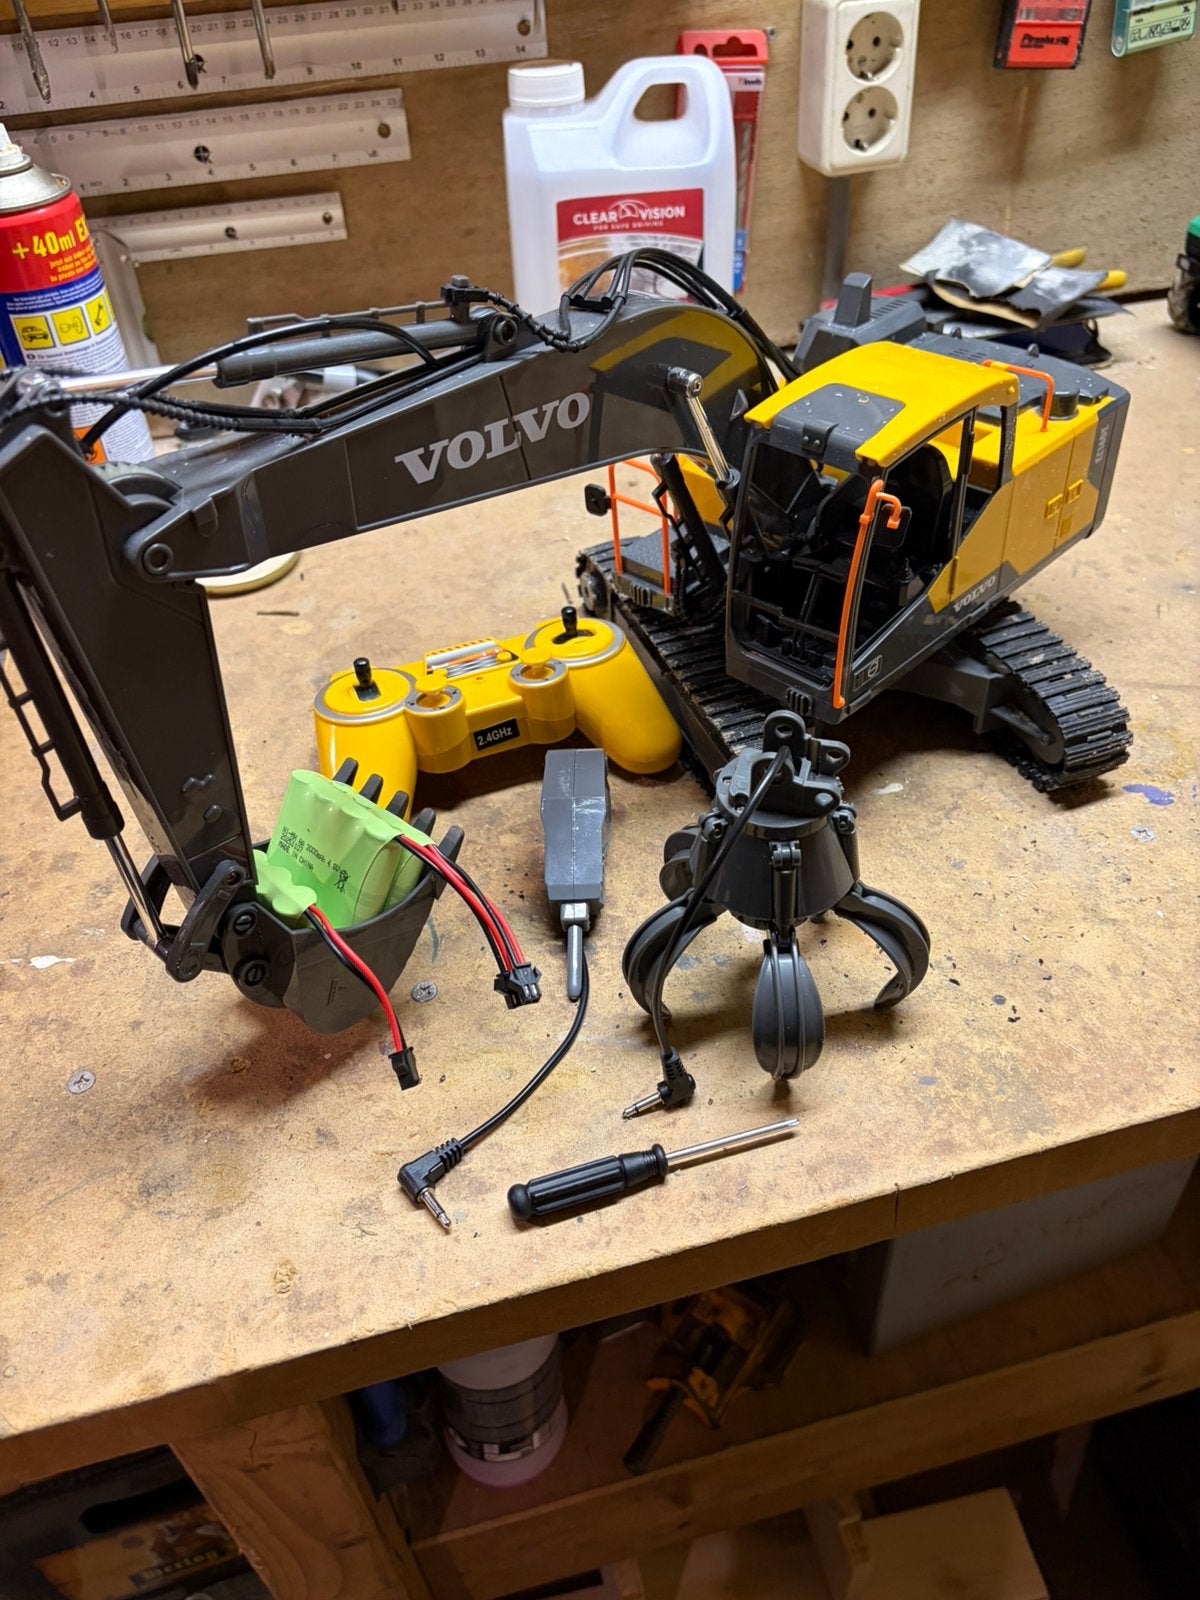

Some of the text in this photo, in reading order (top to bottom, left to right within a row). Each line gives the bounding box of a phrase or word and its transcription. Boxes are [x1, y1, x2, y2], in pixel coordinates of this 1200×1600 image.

[11, 42, 23, 51] 10
[48, 38, 60, 47] 12
[66, 36, 78, 45] 13
[84, 35, 96, 44] 14
[120, 31, 132, 39] 16
[138, 29, 149, 37] 17
[191, 24, 202, 33] 20
[207, 23, 218, 31] 21
[224, 20, 236, 29] 22
[242, 19, 254, 28] 23
[277, 15, 288, 24] 25
[294, 13, 305, 22] 26
[311, 11, 322, 20] 27
[328, 10, 340, 19] 28
[345, 8, 356, 18] 29
[362, 7, 374, 15] 30
[379, 5, 389, 14] 31
[89, 90, 96, 99] 4
[133, 84, 141, 94] 5
[177, 79, 185, 89] 6
[220, 74, 227, 84] 7
[306, 66, 313, 75] 9
[351, 61, 363, 71] 10
[393, 57, 403, 67] 11
[433, 52, 446, 62] 12
[475, 47, 487, 58] 13
[515, 44, 527, 54] 14
[138, 124, 149, 132] 10
[122, 177, 129, 187] 2
[164, 172, 172, 182] 3
[207, 167, 215, 176] 4
[248, 162, 257, 172] 5
[290, 157, 298, 167] 6
[331, 151, 338, 162] 7
[573, 206, 686, 226] CLEAR VISION
[32, 229, 77, 257] 40ml
[394, 392, 590, 484] VOLVO
[952, 575, 996, 613] VOLVO
[477, 727, 513, 746] 2.4GHz
[298, 855, 314, 872] CHINA
